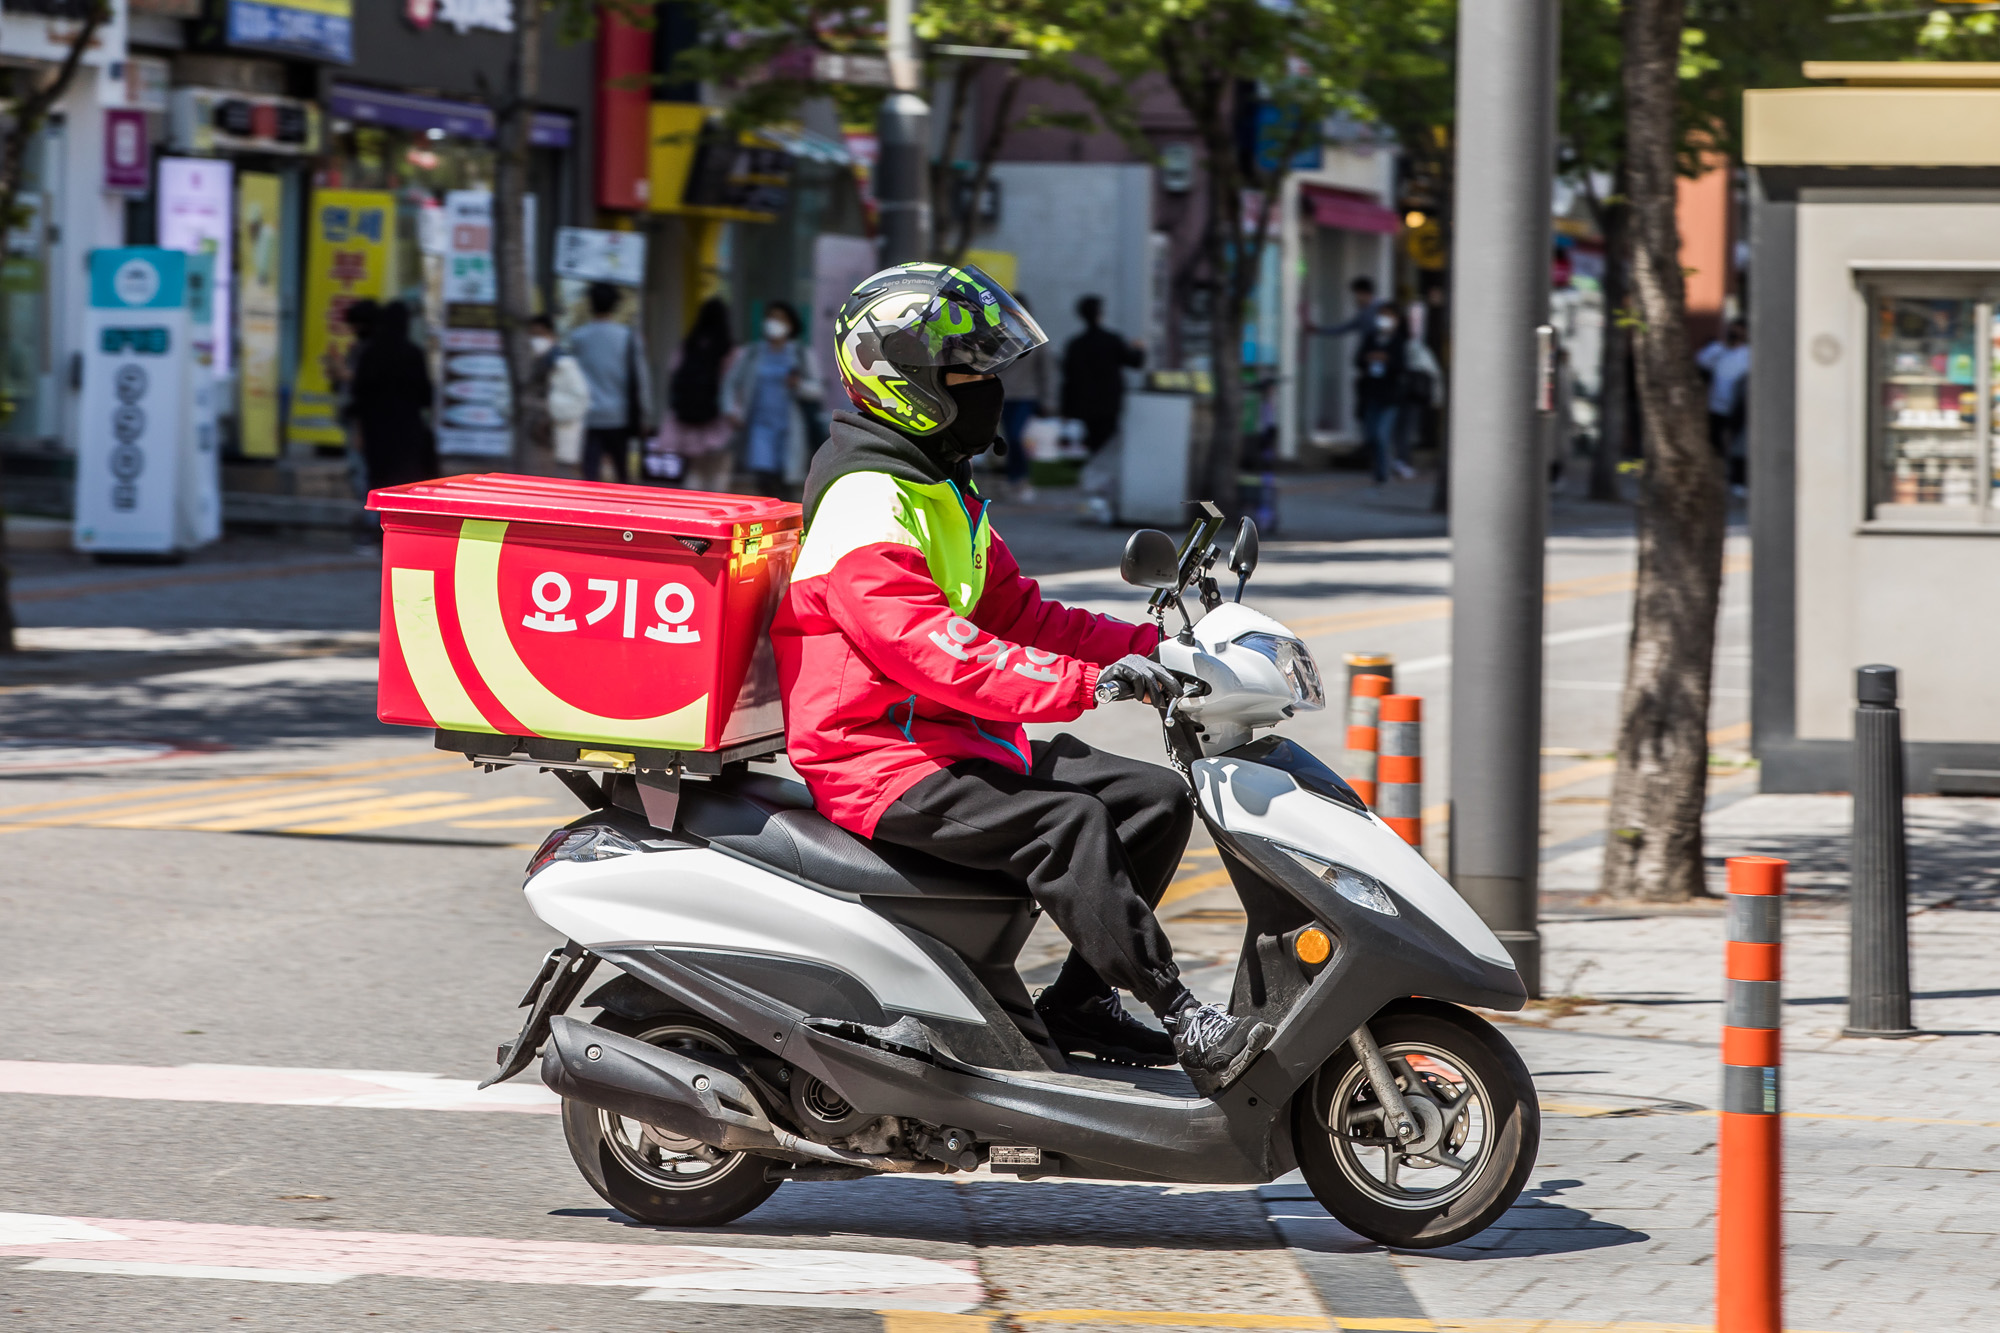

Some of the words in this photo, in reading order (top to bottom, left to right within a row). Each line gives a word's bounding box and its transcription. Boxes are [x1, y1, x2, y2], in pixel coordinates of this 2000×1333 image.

[902, 278, 935, 286] Dynamic
[901, 388, 928, 409] DYNAMIC
[974, 553, 983, 569] 요
[522, 571, 702, 644] 요기요
[928, 617, 1059, 683] 요기요
